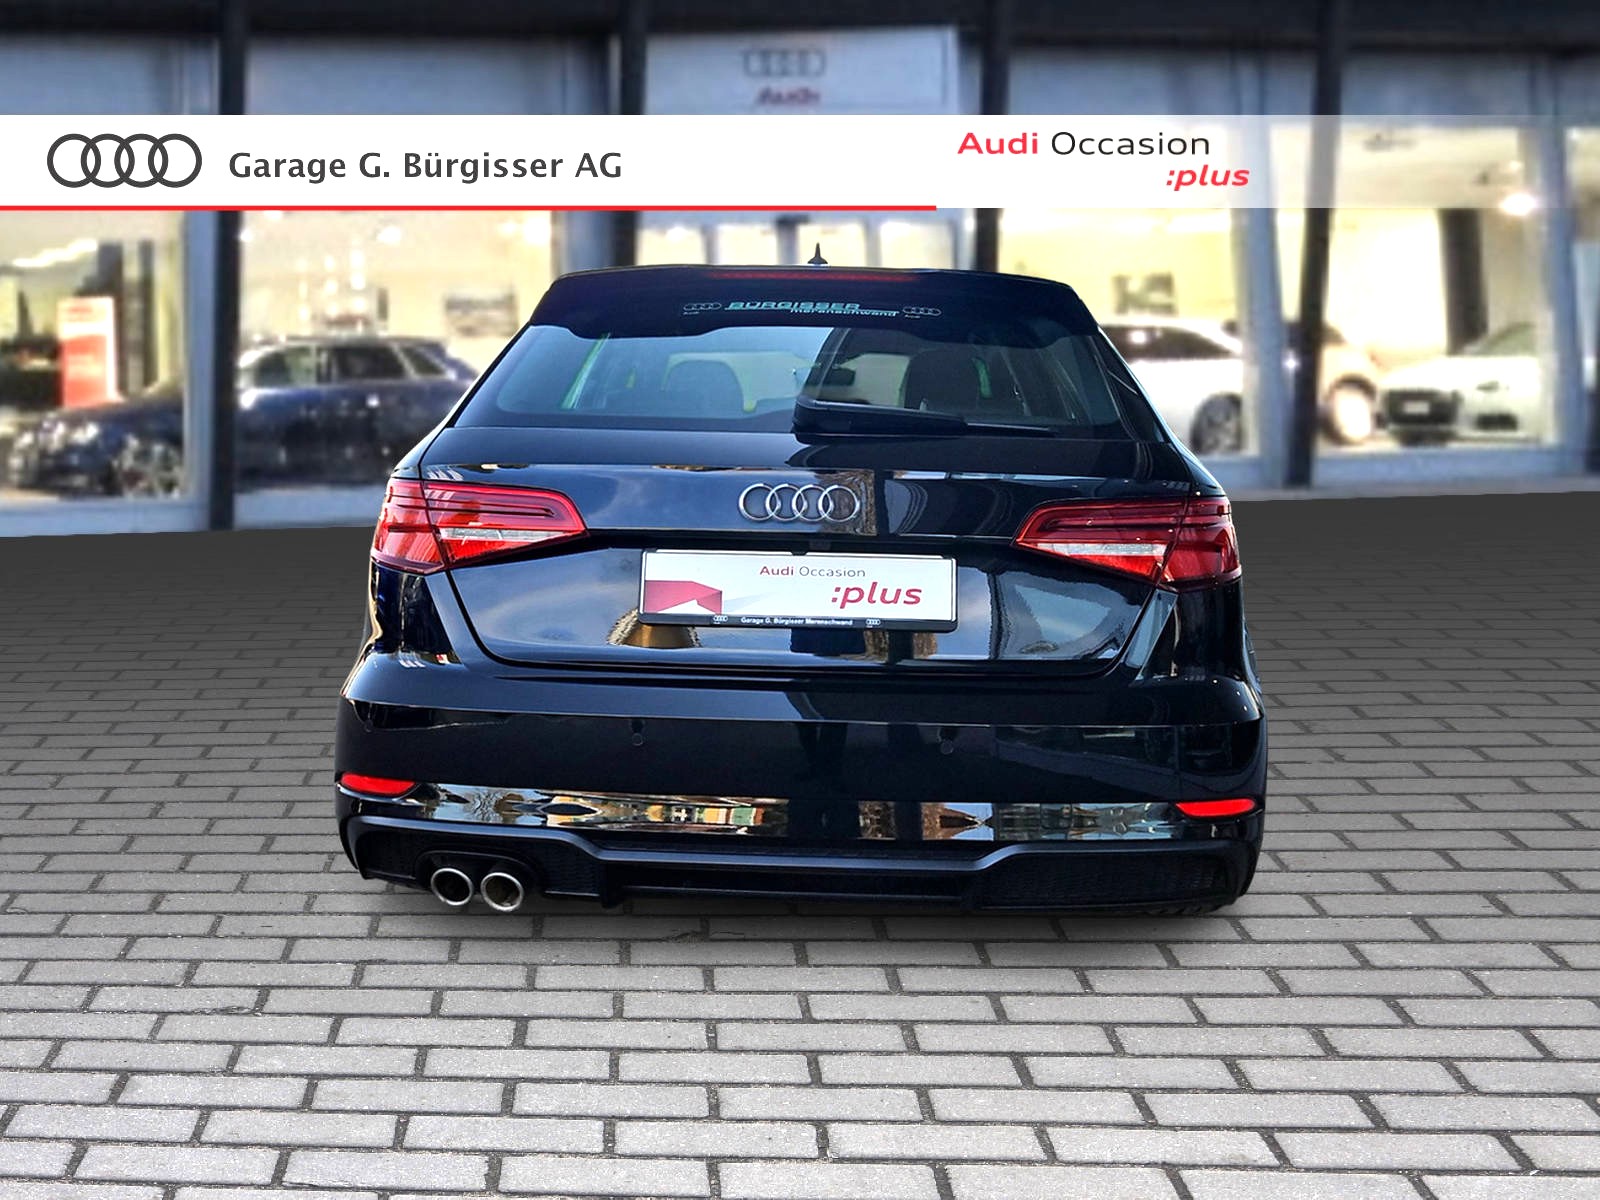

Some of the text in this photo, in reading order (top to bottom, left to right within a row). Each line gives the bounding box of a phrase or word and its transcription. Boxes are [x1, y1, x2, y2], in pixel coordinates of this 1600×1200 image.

[759, 565, 866, 578] Audi Occasion
[831, 581, 923, 609] :plus
[740, 616, 764, 625] Garage
